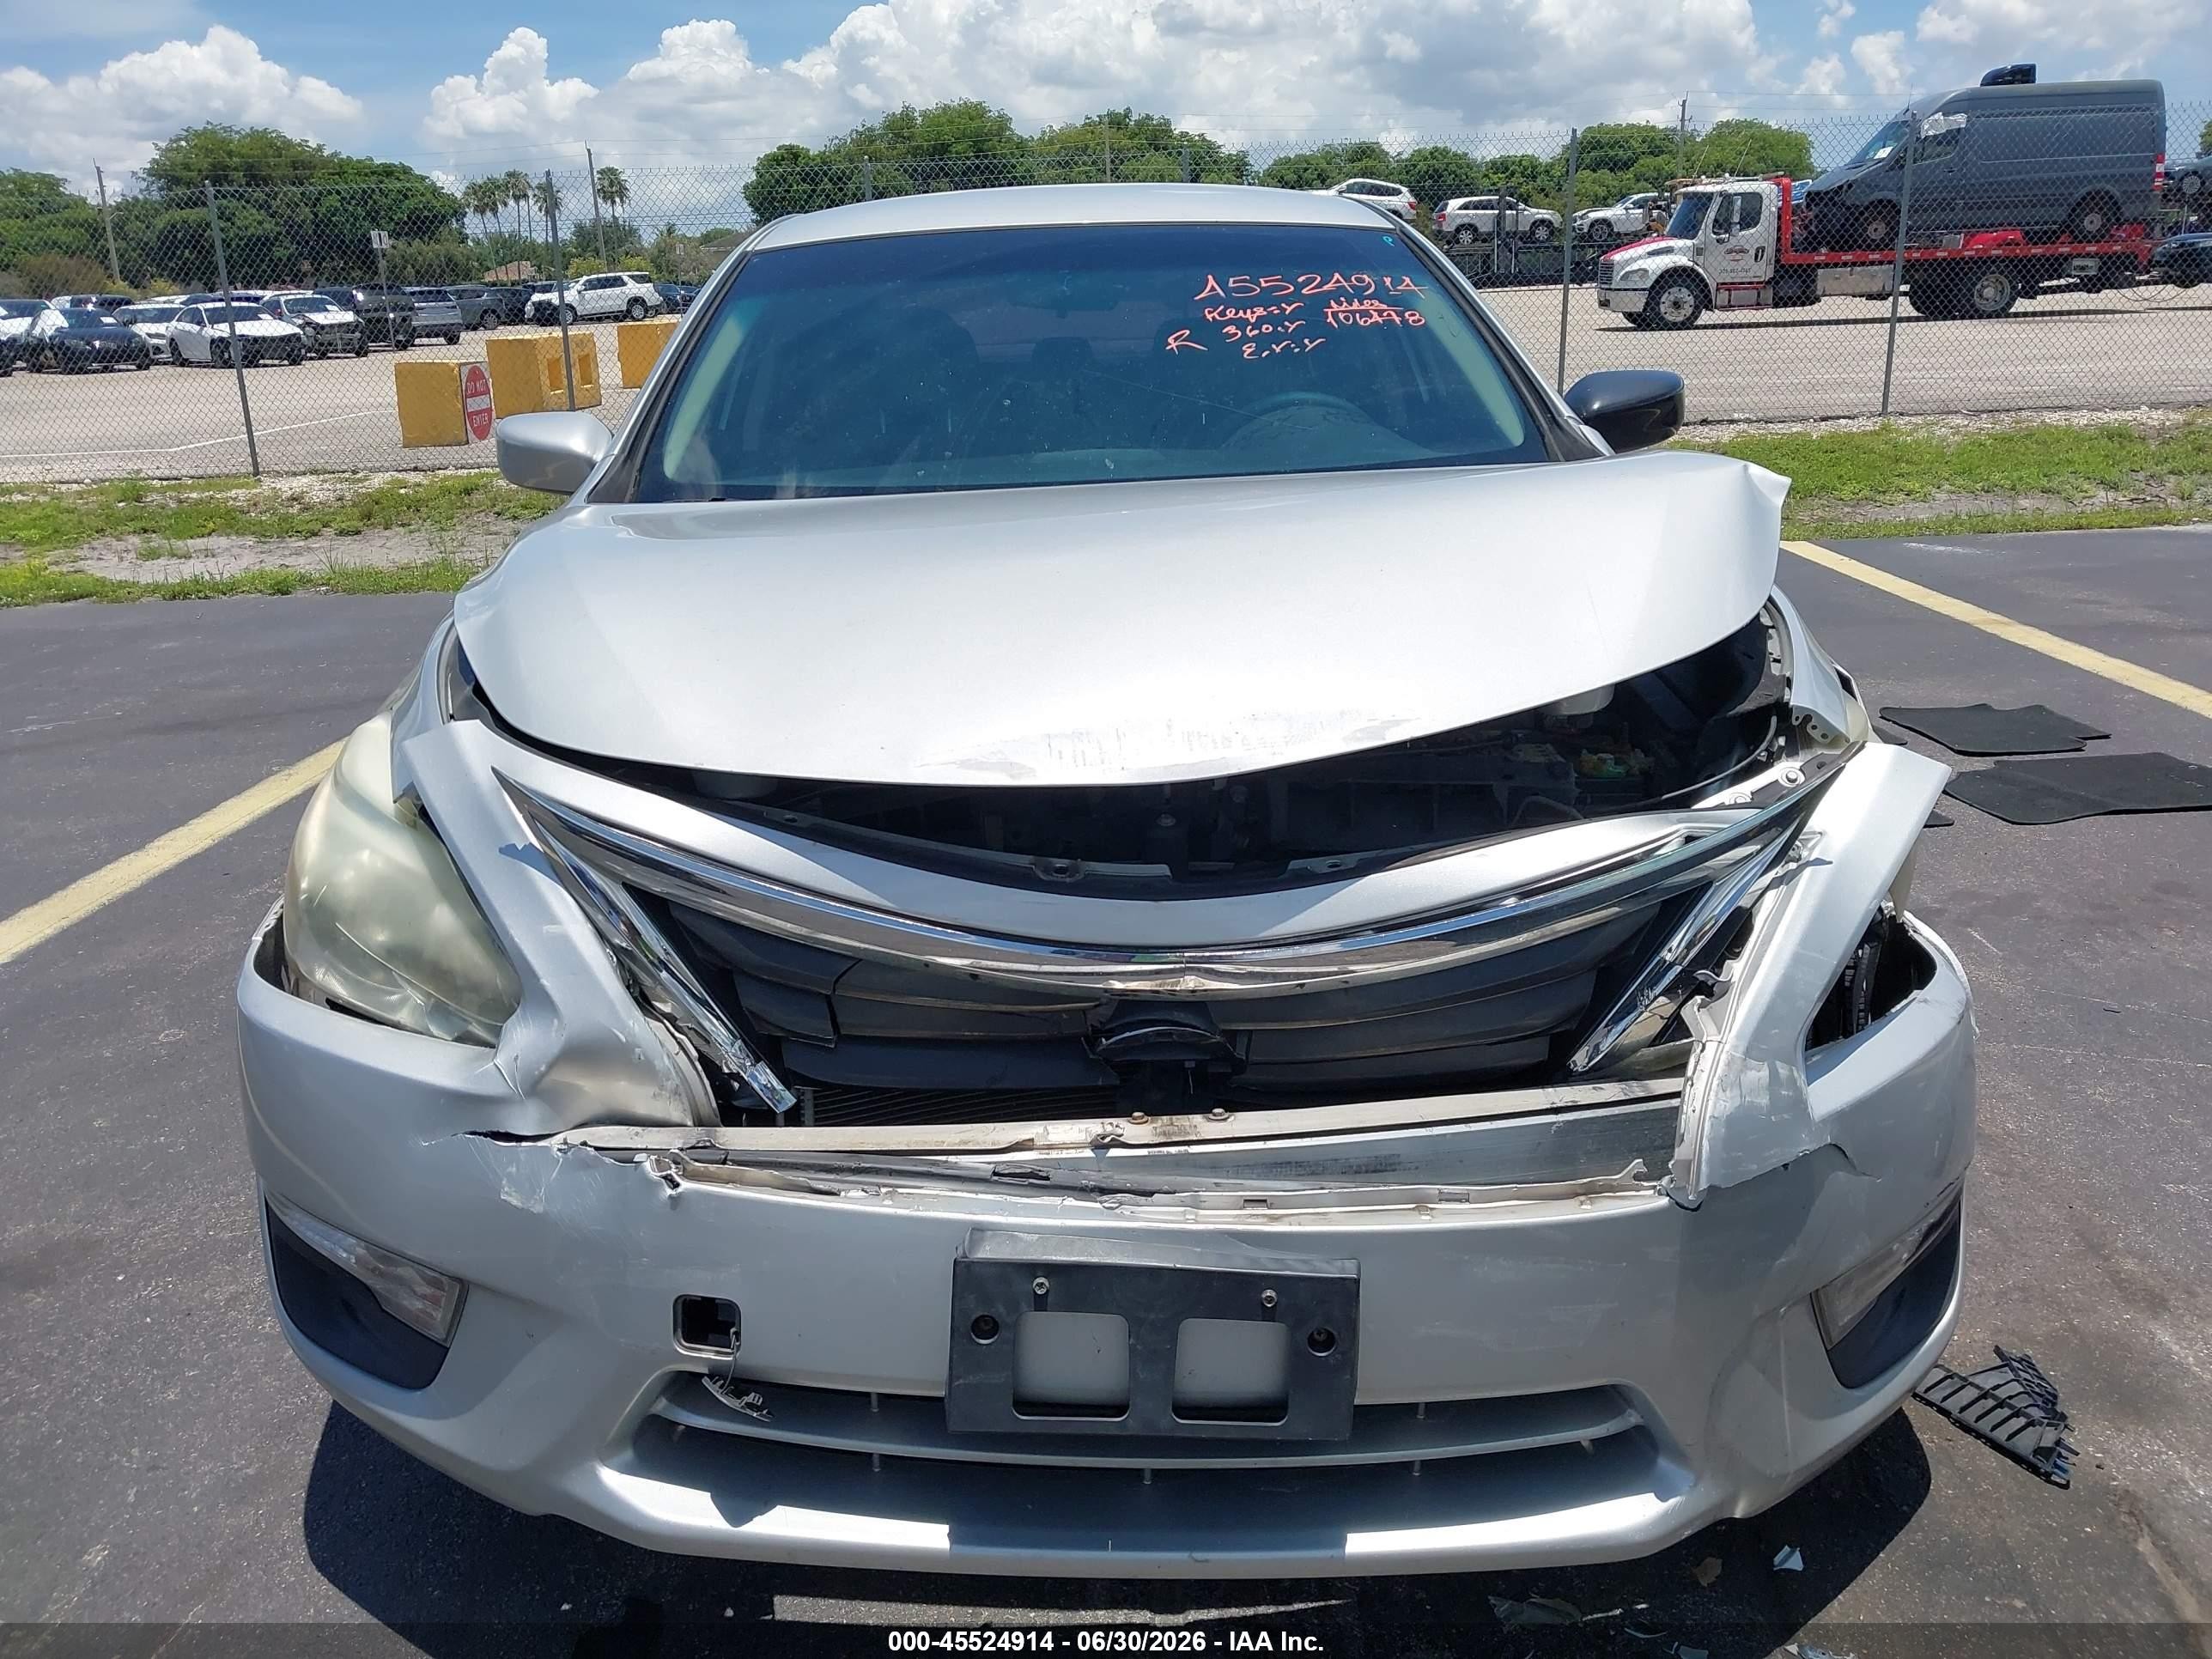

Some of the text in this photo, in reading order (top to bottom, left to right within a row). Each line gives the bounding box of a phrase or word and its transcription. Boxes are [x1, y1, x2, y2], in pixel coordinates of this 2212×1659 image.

[467, 379, 486, 393] DO NOT
[472, 413, 489, 427] ENTER
